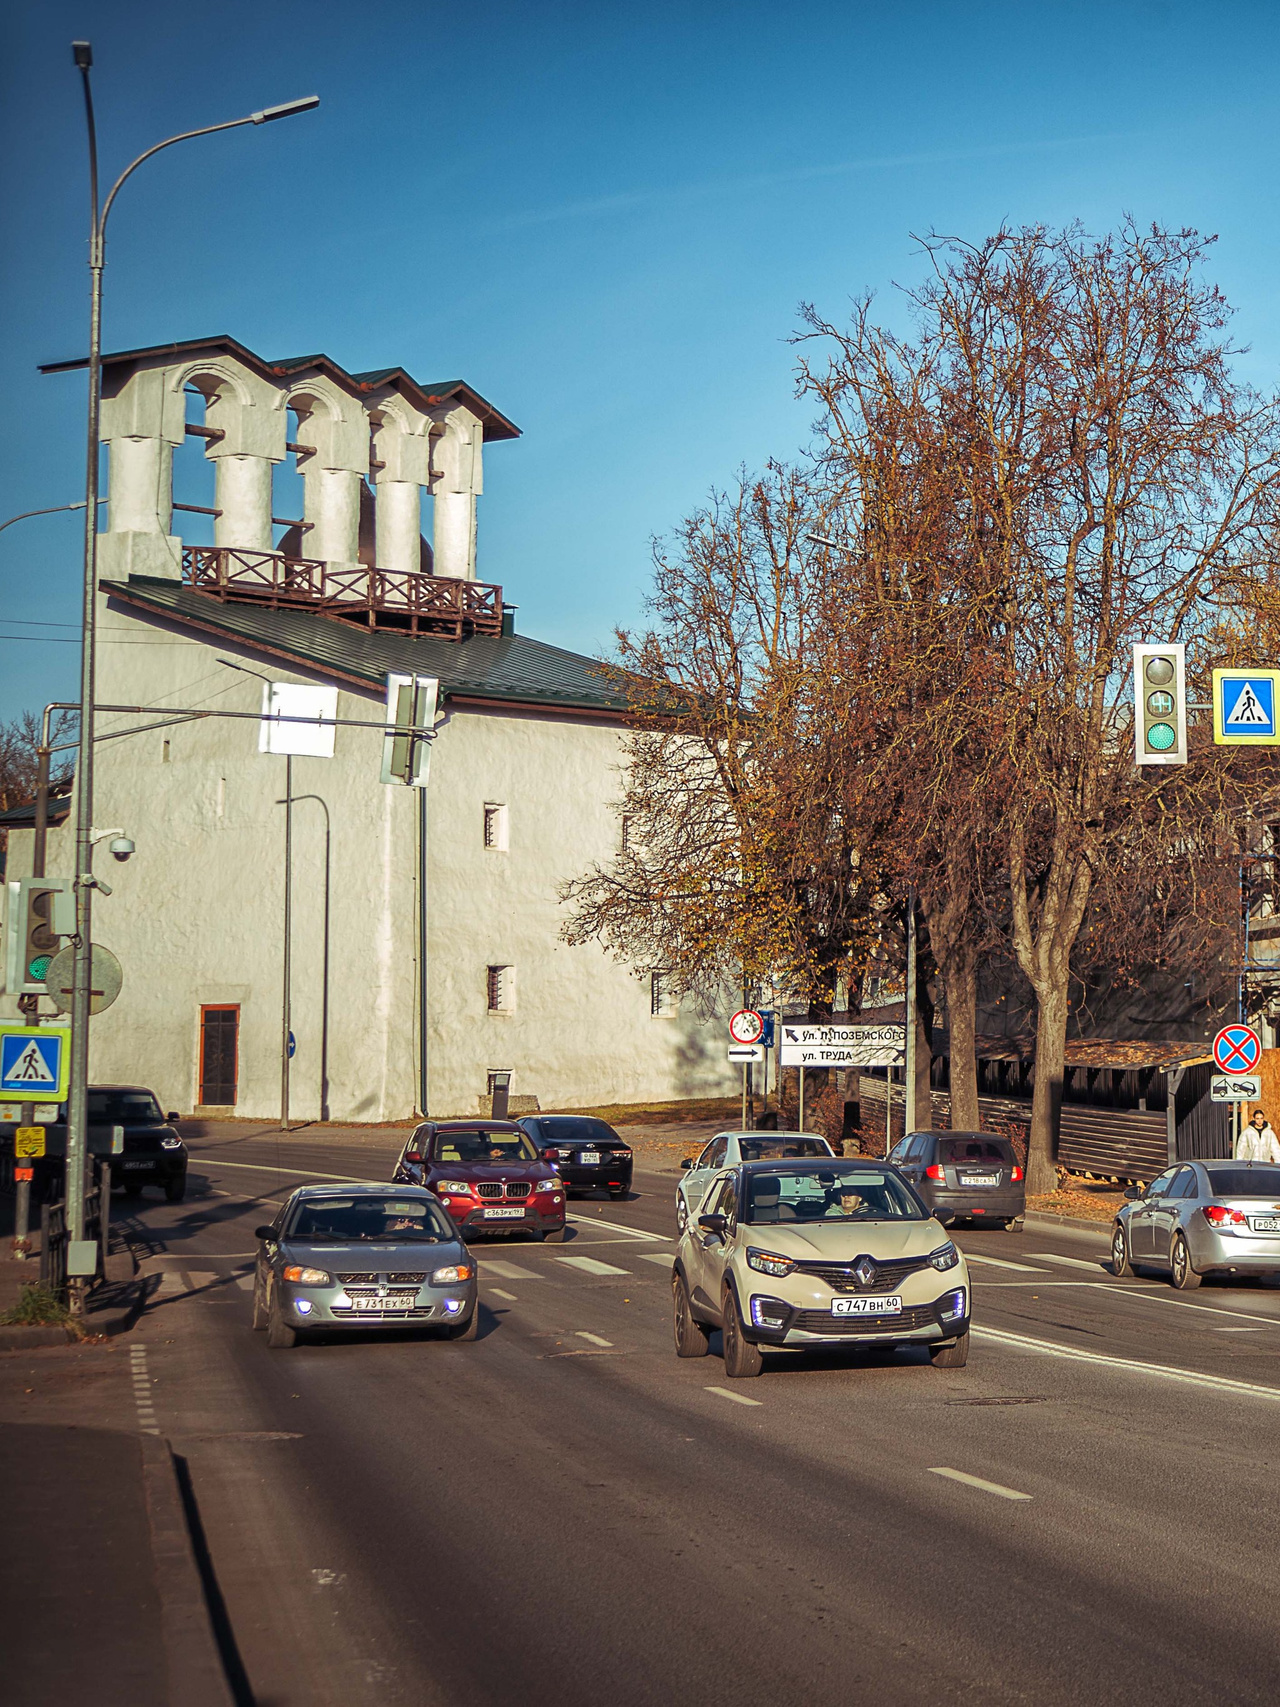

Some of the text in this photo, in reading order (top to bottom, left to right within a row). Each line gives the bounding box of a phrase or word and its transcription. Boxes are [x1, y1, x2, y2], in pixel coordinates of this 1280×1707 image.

[833, 1030, 906, 1041] ПОЗЕМСКОГО
[802, 1051, 853, 1062] ул. ТРУДА
